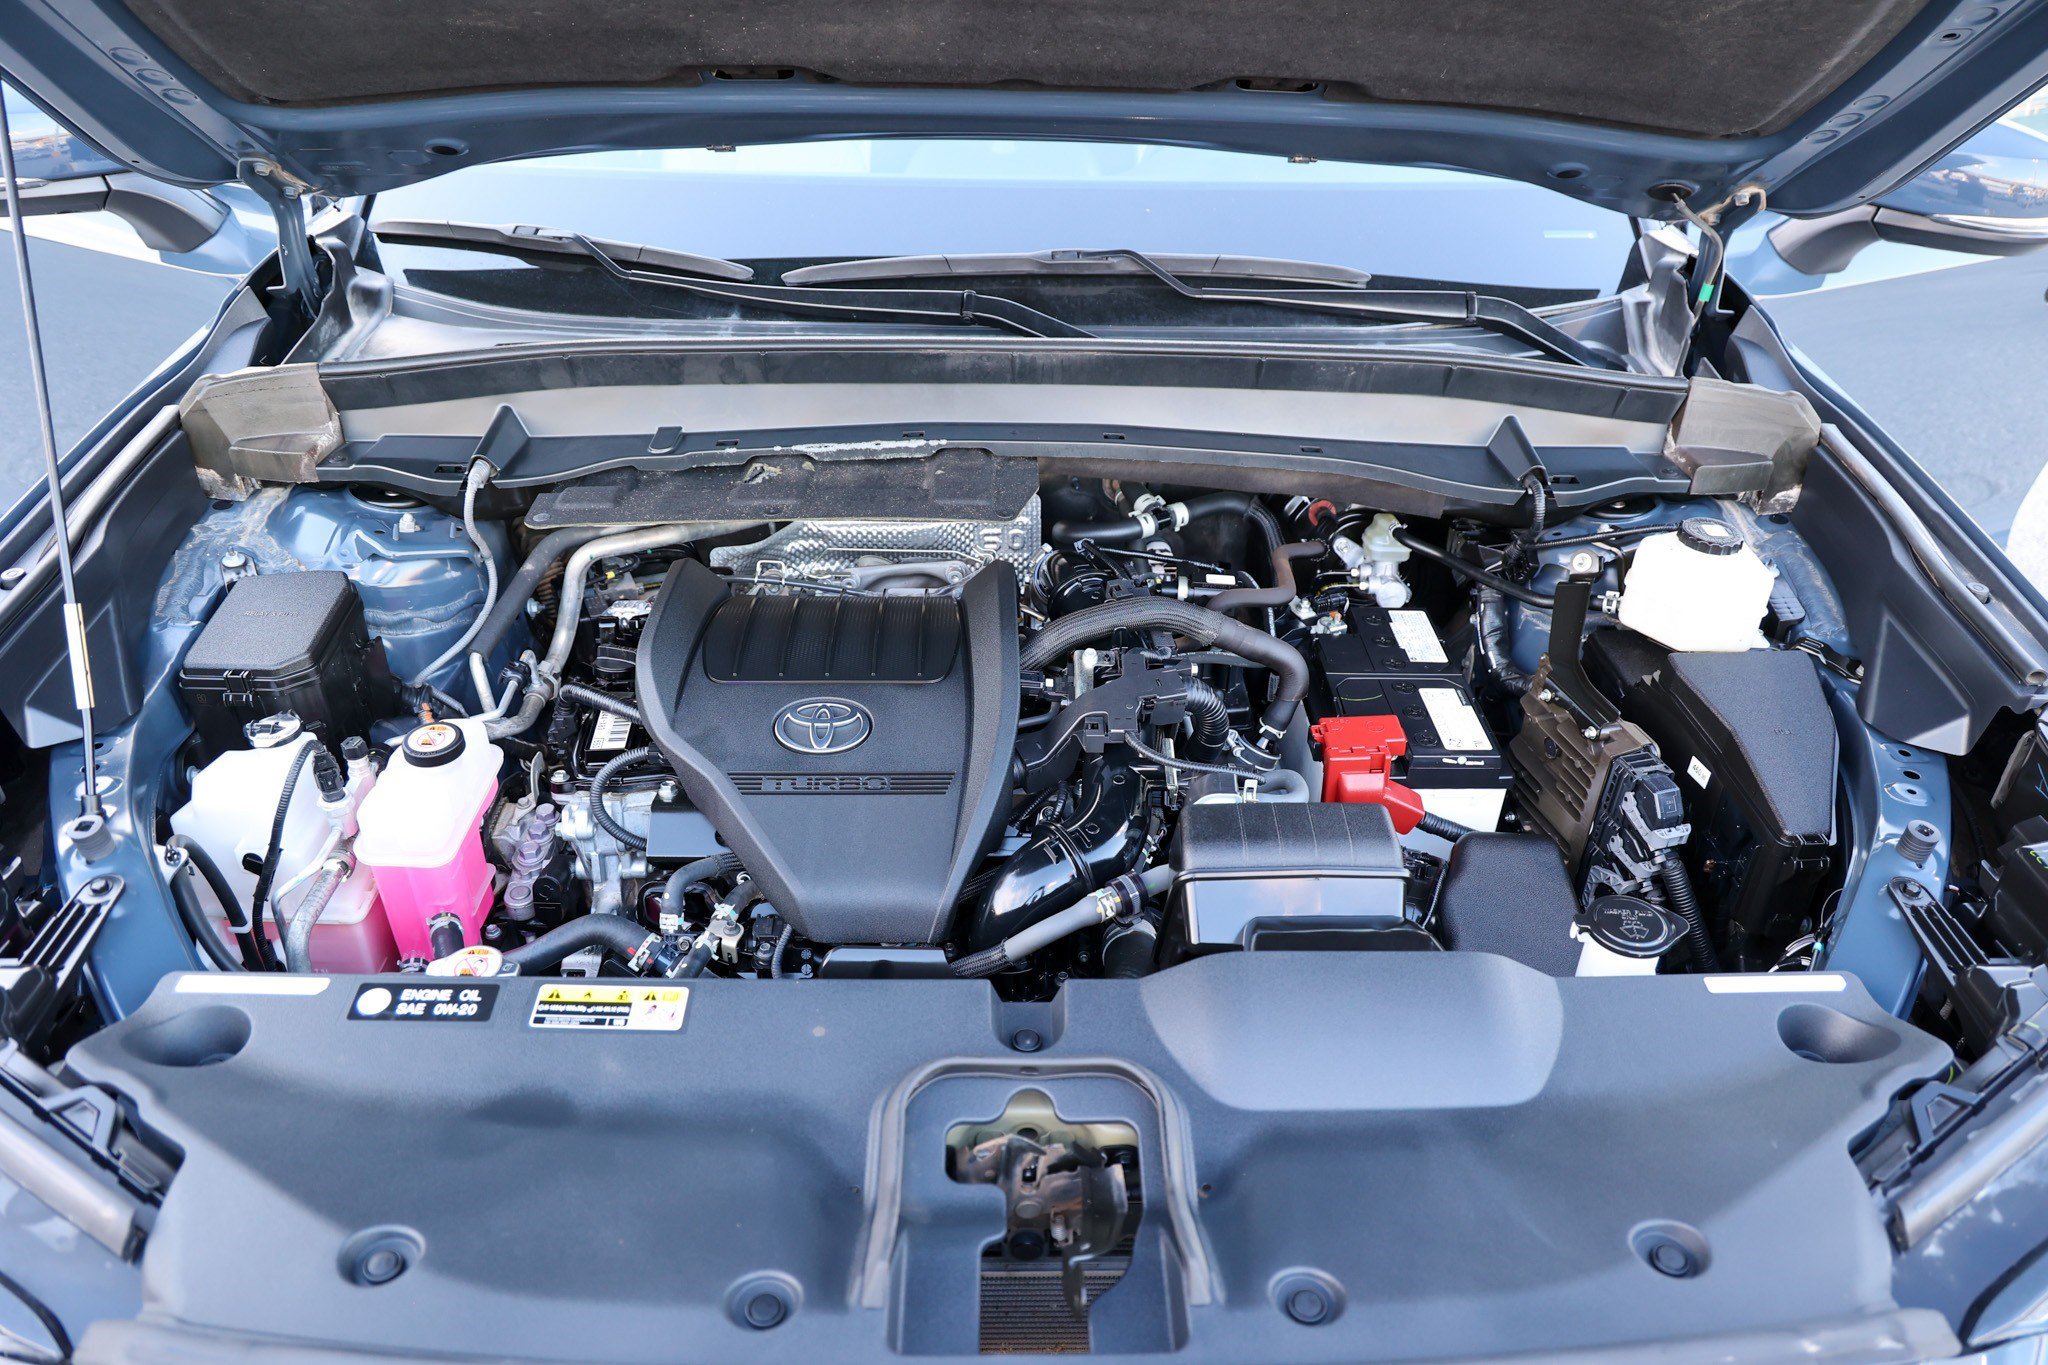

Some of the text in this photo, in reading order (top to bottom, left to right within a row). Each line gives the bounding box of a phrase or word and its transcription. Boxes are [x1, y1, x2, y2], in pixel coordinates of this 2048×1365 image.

[761, 775, 888, 791] TURBO
[400, 988, 482, 1001] ENGINE OIL
[395, 1002, 478, 1016] SAE 0W-20
